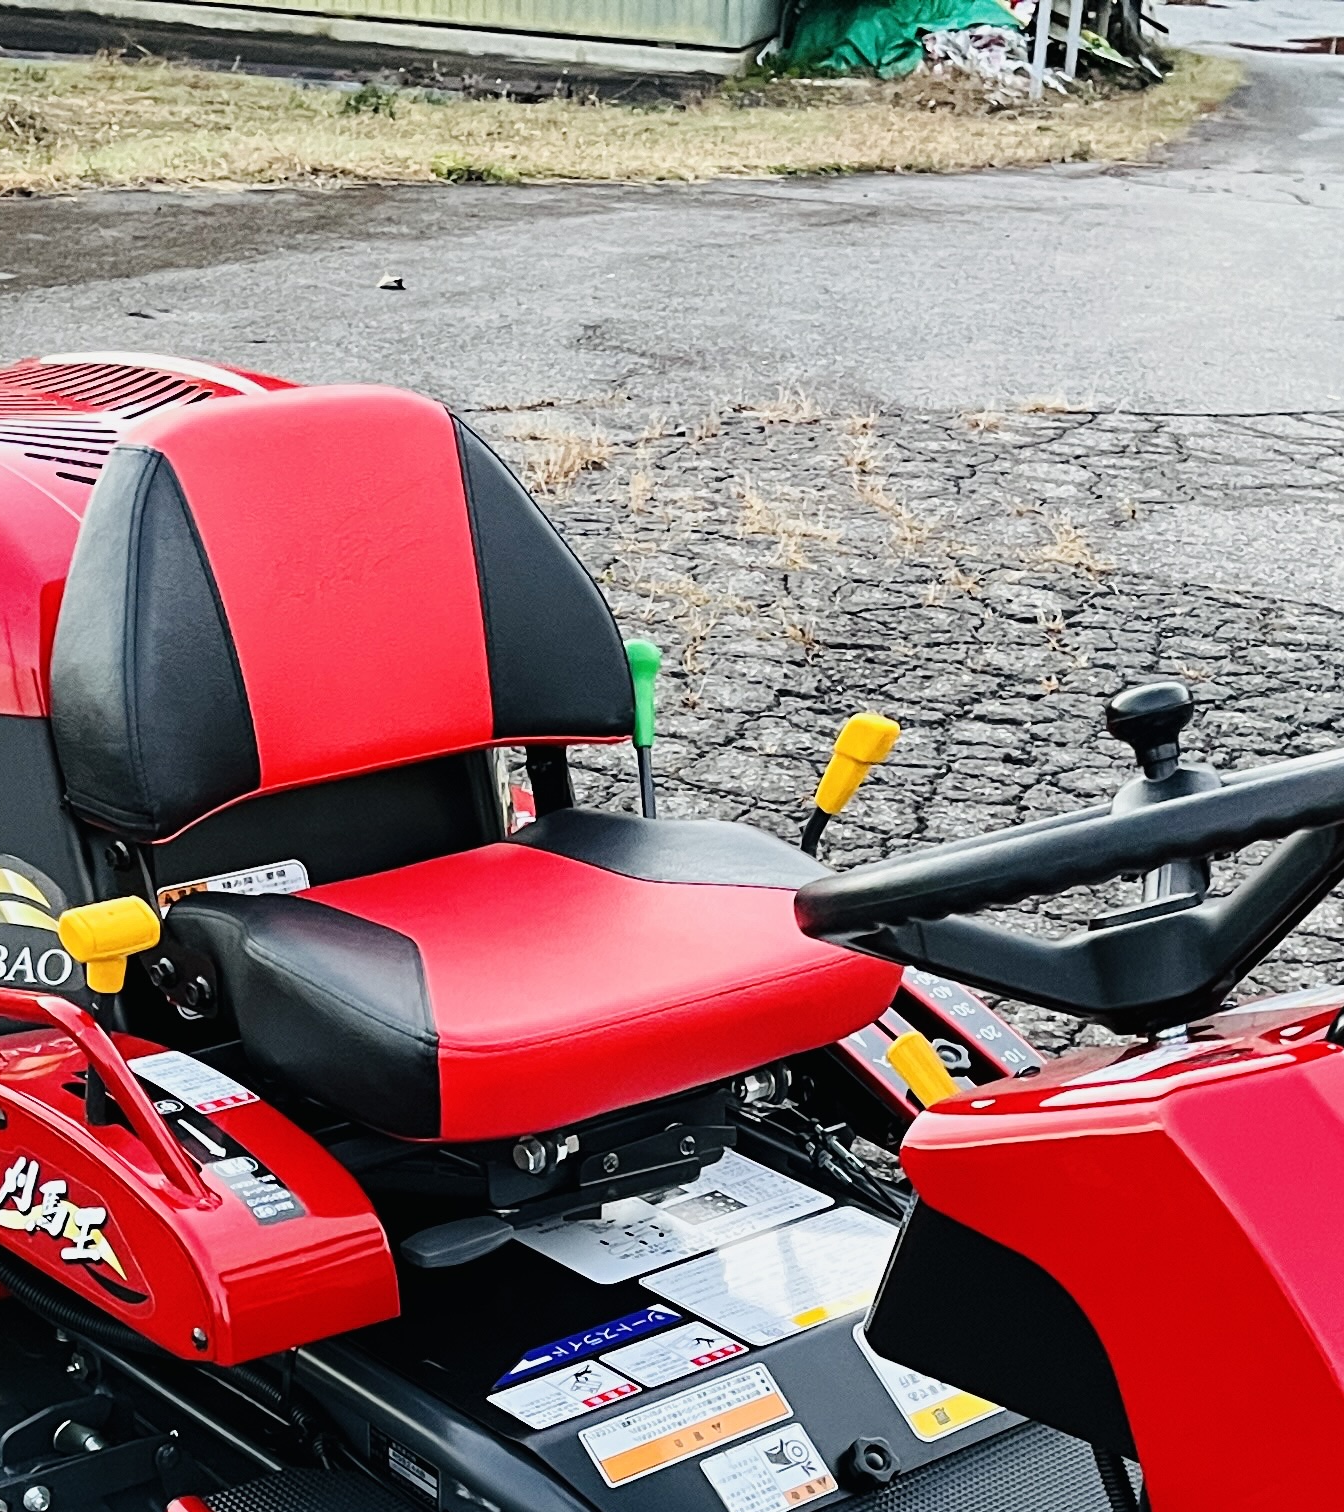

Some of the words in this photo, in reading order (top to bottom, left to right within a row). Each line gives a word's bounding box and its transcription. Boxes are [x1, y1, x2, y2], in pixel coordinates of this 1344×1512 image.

[932, 985, 953, 999] 40
[953, 1001, 976, 1017] 30
[979, 1024, 1002, 1041] 20
[1004, 1047, 1027, 1064] 10
[551, 1309, 665, 1359] シートスライド
